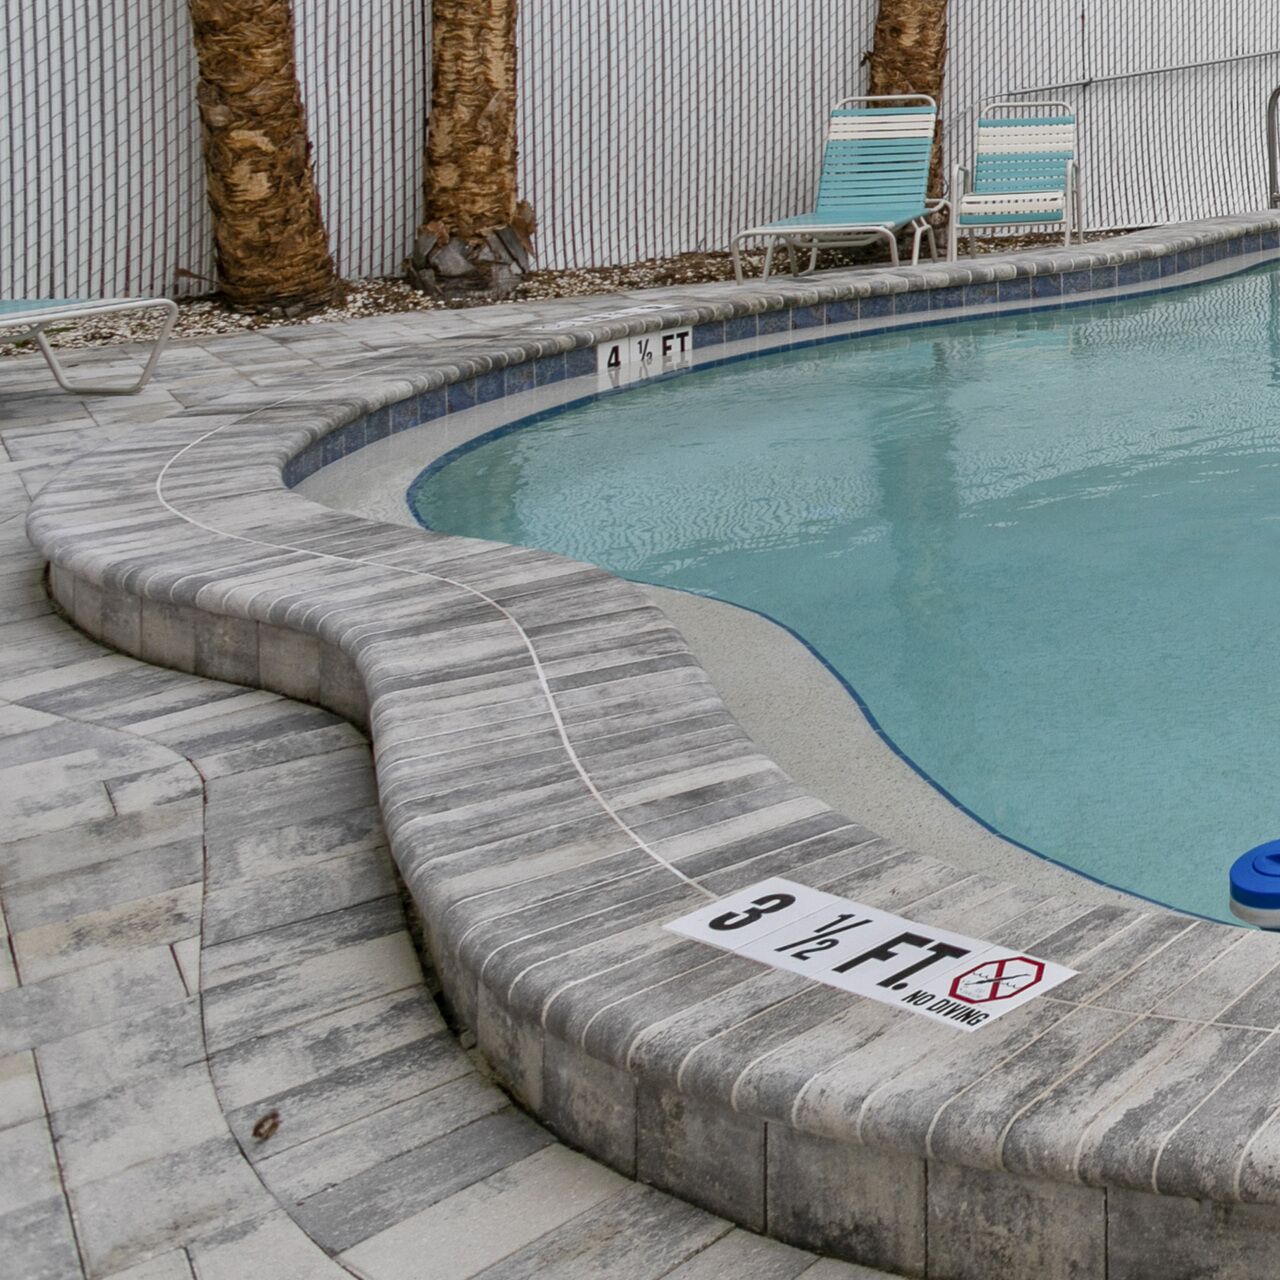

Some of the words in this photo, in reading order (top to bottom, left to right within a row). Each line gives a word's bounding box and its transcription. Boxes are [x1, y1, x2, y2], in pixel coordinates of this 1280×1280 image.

[607, 345, 621, 368] 4
[662, 331, 689, 356] FT
[708, 893, 796, 931] 3
[901, 989, 936, 1006] NO
[926, 998, 990, 1026] DIVING
